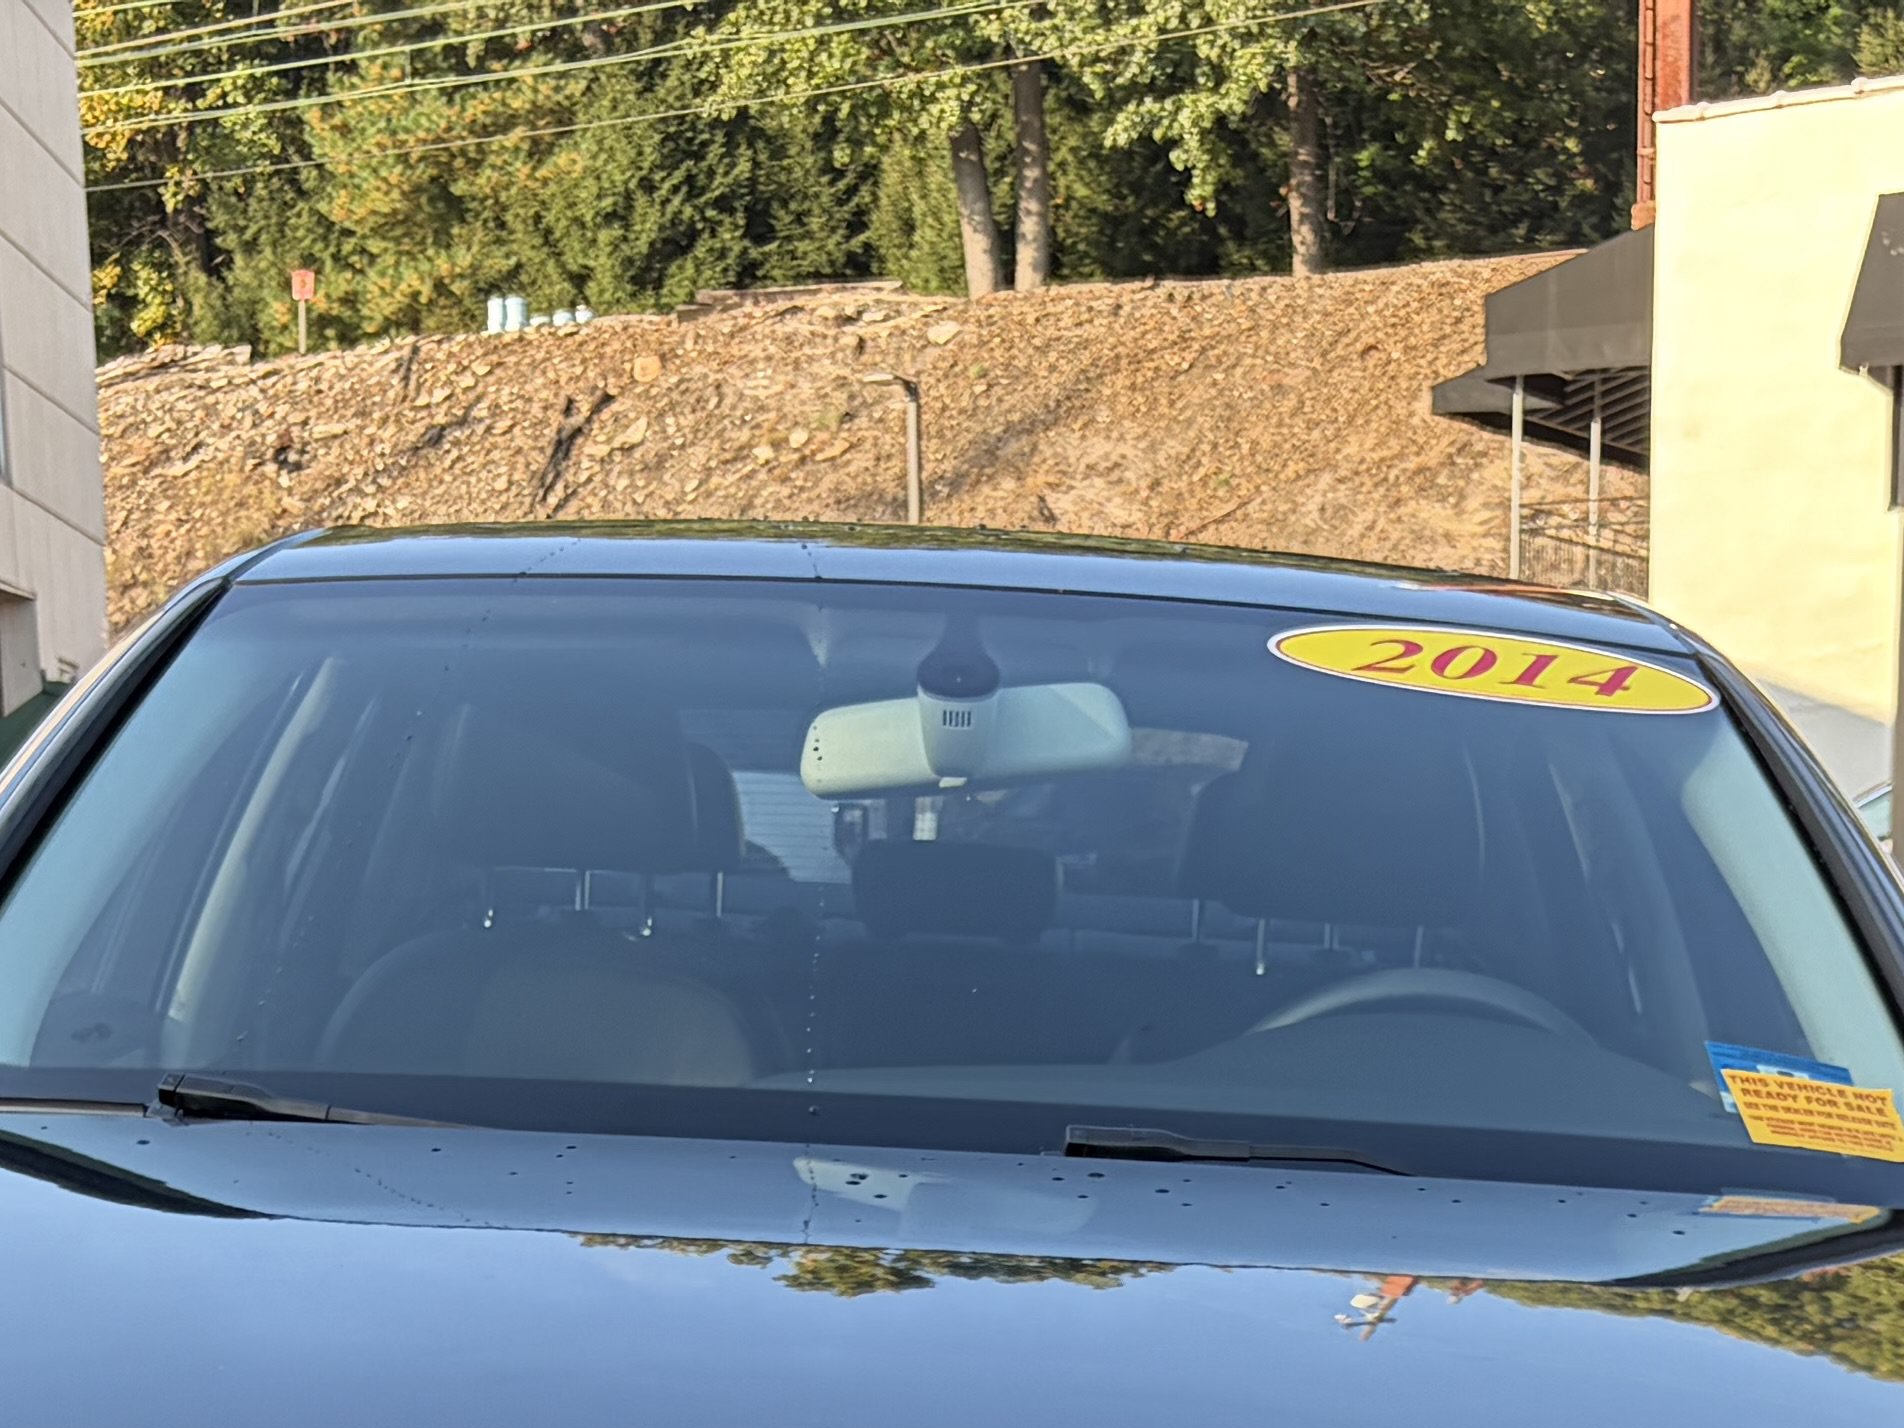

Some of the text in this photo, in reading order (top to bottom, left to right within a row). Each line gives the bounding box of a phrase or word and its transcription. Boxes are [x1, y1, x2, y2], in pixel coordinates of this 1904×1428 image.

[1351, 639, 1639, 697] 2014
[1728, 1075, 1888, 1106] THIS VEHICLE NOT
[1741, 1088, 1889, 1117] READY FOR SALE
